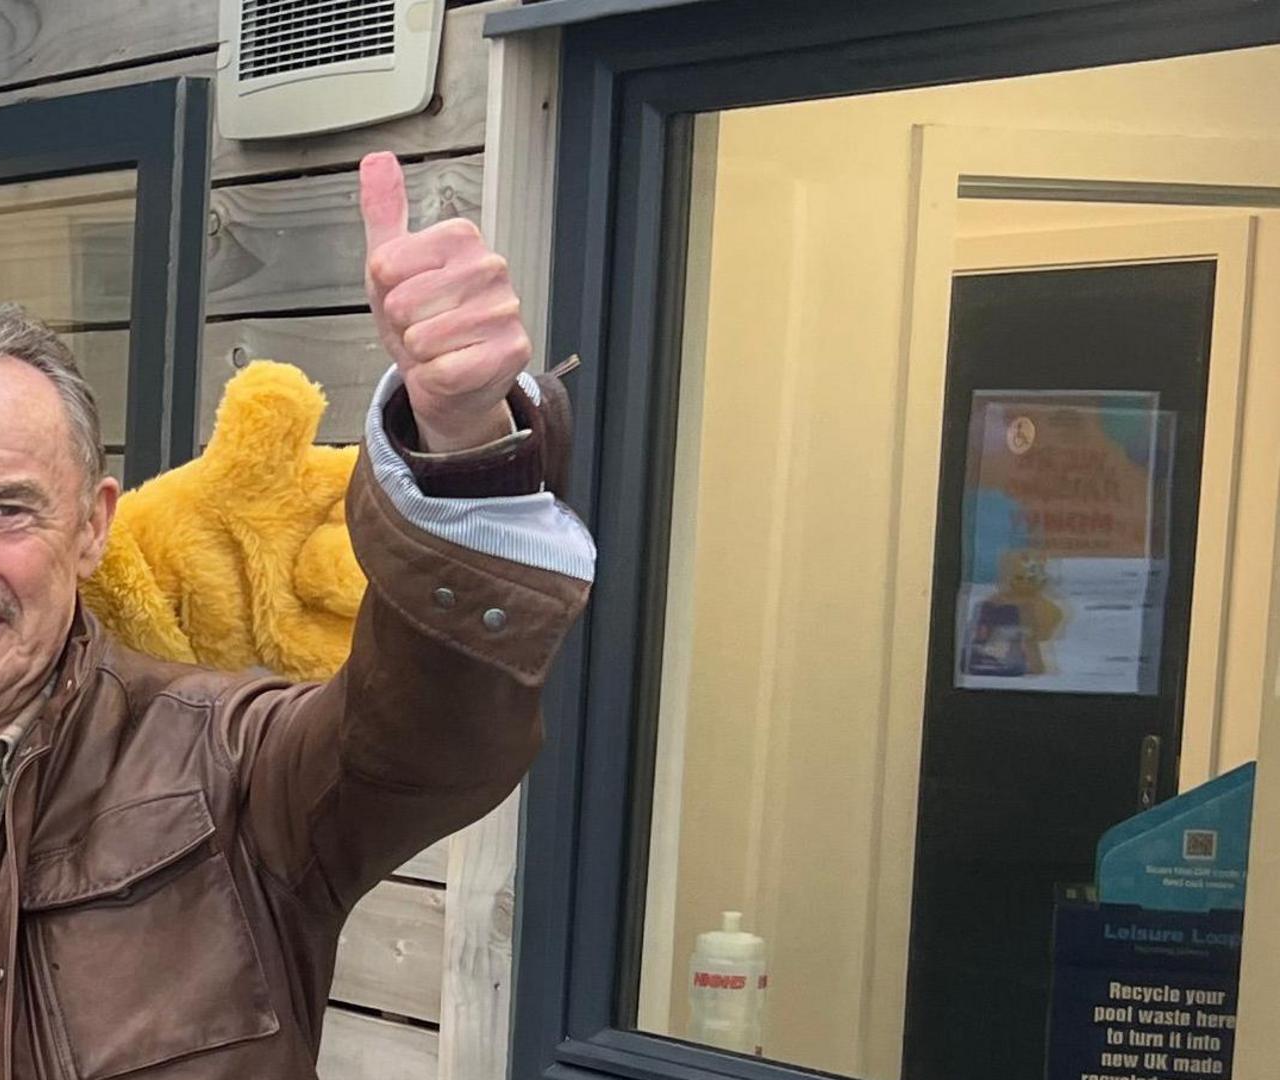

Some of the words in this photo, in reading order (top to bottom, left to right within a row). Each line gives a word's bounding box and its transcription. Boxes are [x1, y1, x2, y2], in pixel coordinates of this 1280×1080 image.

[1104, 923, 1183, 943] Leisure
[1109, 982, 1180, 1003] Recycle
[1185, 989, 1226, 1005] your
[1093, 1006, 1132, 1023] pool
[1138, 1010, 1191, 1026] waste
[1196, 1011, 1236, 1028] here
[1107, 1028, 1123, 1044] to
[1129, 1030, 1163, 1048] turn
[1169, 1031, 1181, 1049] it
[1186, 1031, 1221, 1051] into
[1101, 1053, 1138, 1068] new
[1144, 1053, 1168, 1070] UK
[1173, 1057, 1223, 1073] made
